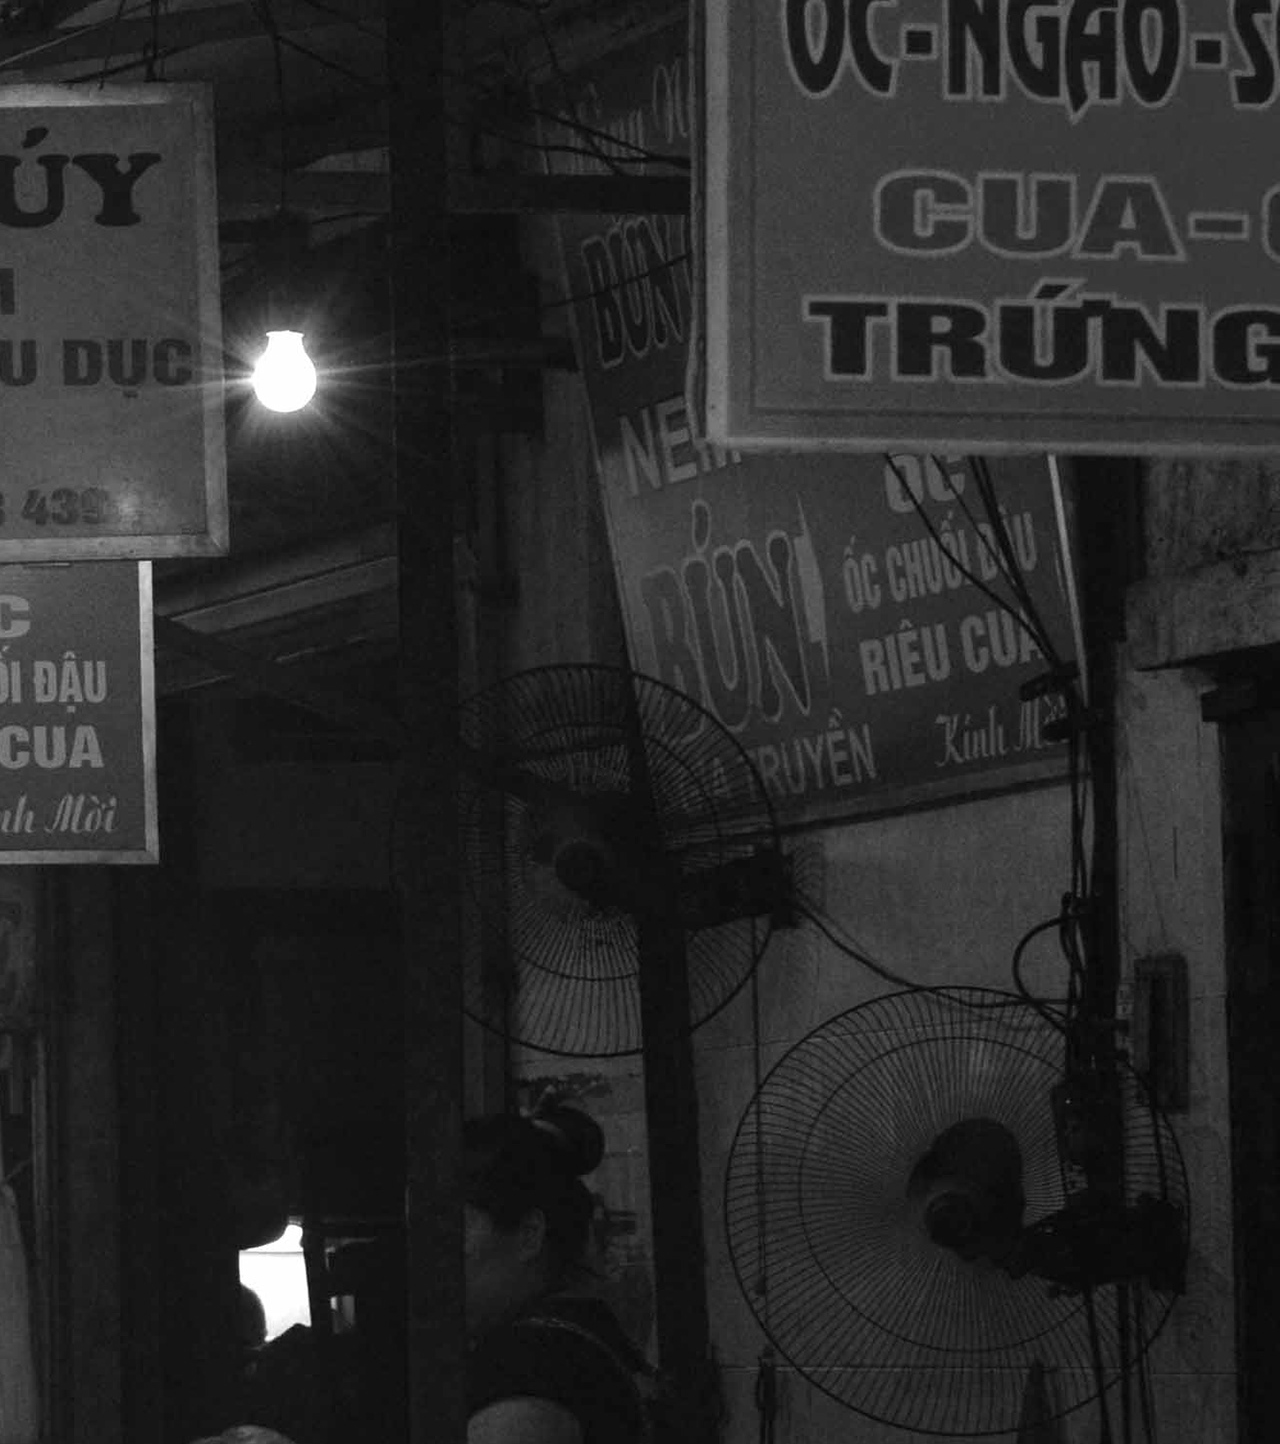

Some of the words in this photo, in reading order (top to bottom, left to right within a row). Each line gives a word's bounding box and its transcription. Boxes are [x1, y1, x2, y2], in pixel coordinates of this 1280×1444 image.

[873, 167, 1280, 262] CUA-
[63, 338, 192, 399] DỤC
[34, 660, 106, 713] ĐẬU
[859, 620, 950, 696] RIÊU
[46, 793, 119, 834] Mời
